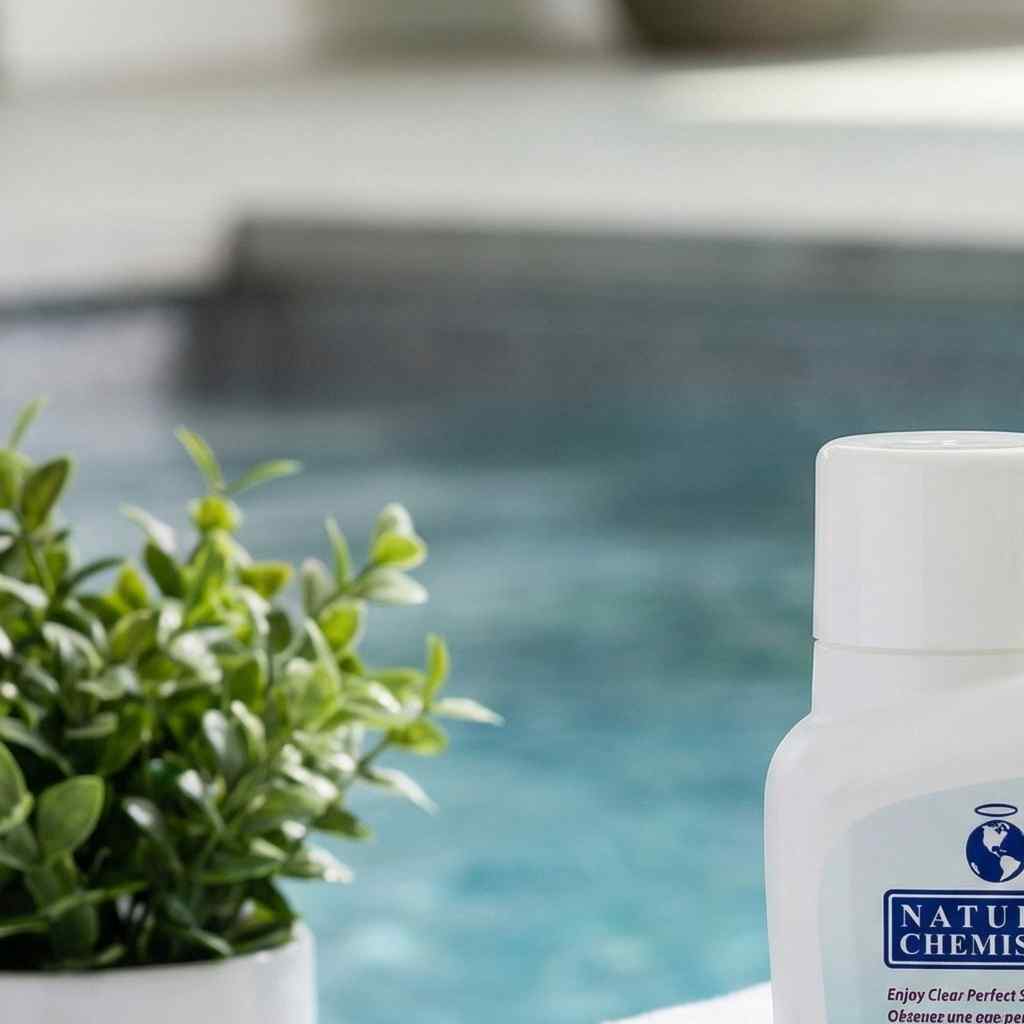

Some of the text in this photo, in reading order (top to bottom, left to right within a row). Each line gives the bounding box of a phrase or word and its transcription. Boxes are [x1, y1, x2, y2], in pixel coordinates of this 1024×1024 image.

[887, 988, 925, 1004] Enjoy
[928, 988, 964, 1002] Clear
[967, 988, 1016, 1002] Perfect
[947, 1013, 972, 1023] une
